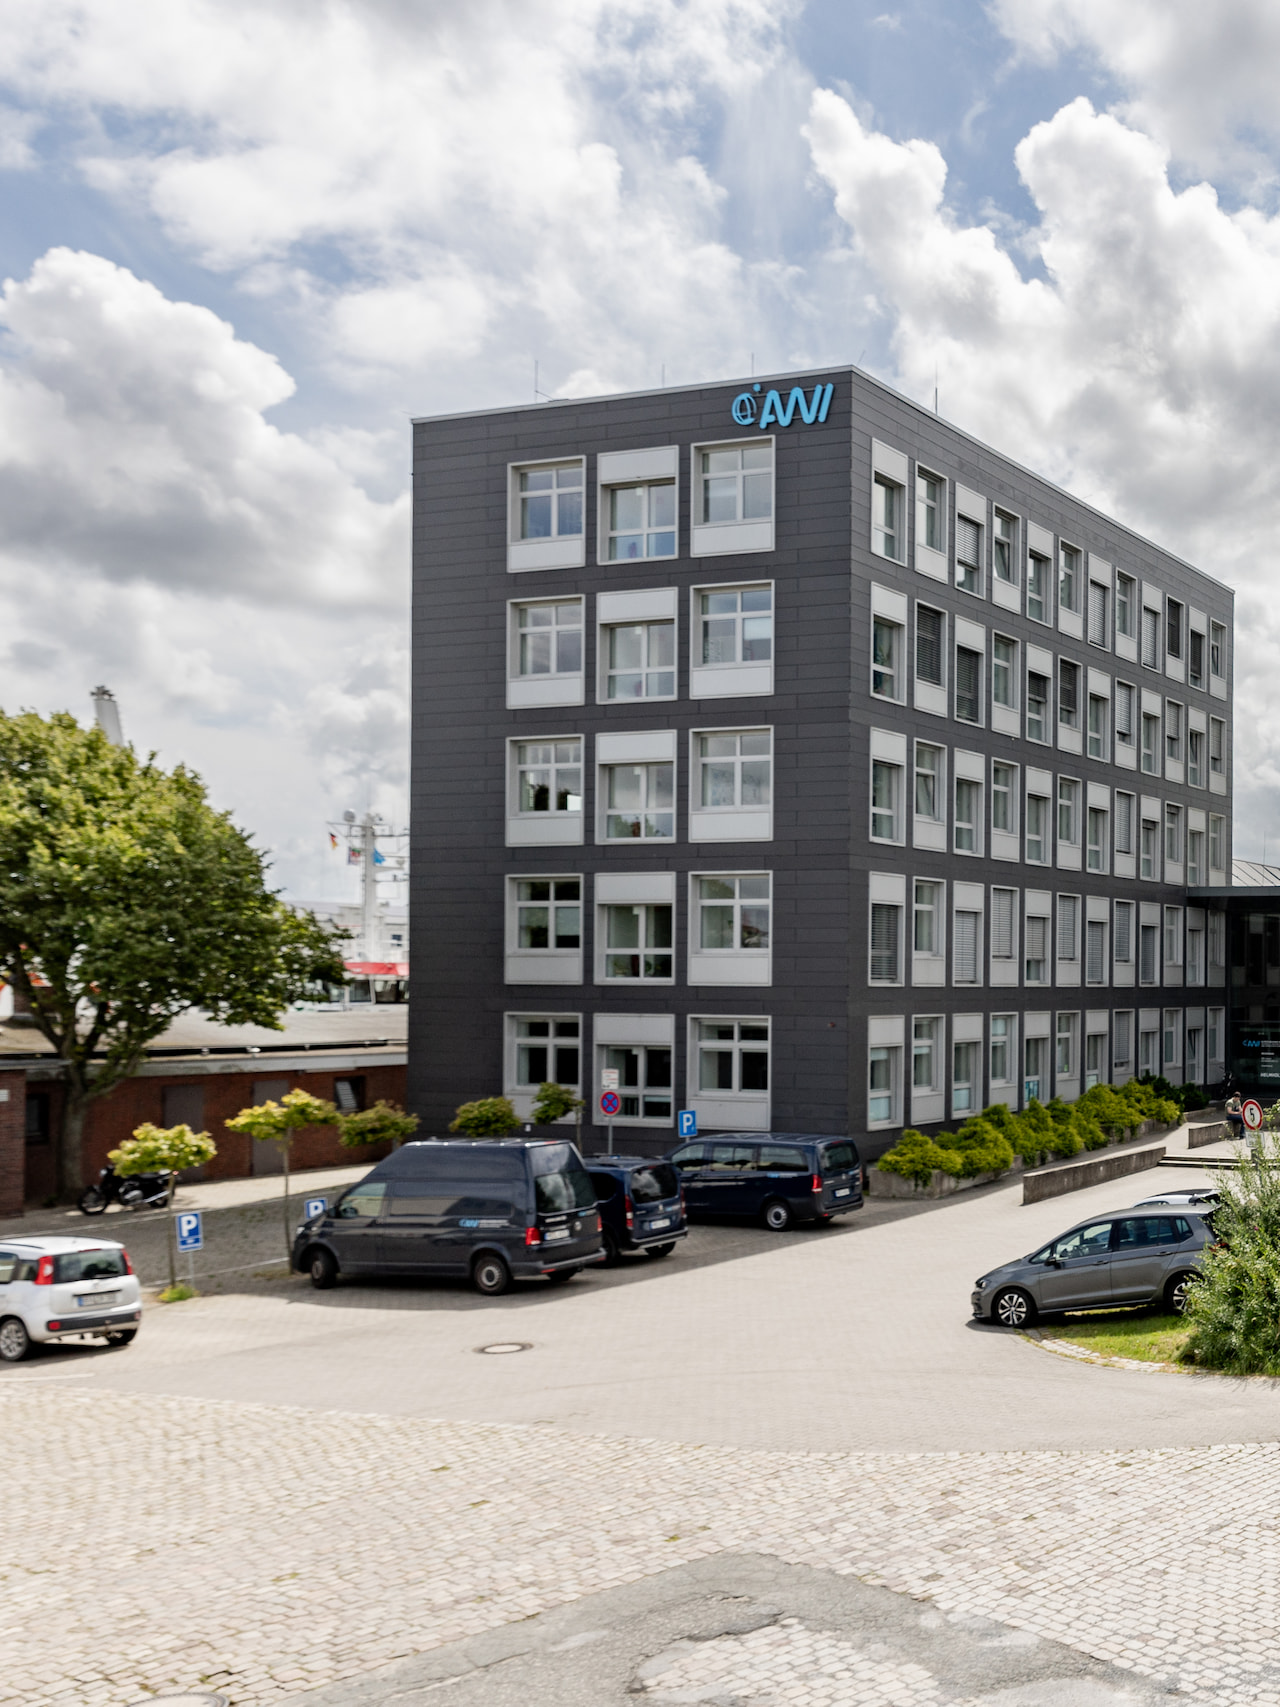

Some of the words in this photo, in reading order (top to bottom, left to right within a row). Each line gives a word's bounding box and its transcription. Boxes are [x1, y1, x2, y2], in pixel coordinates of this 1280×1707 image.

[759, 383, 834, 430] AWI
[682, 1113, 694, 1134] P
[1249, 1107, 1256, 1123] 5
[180, 1215, 198, 1237] P
